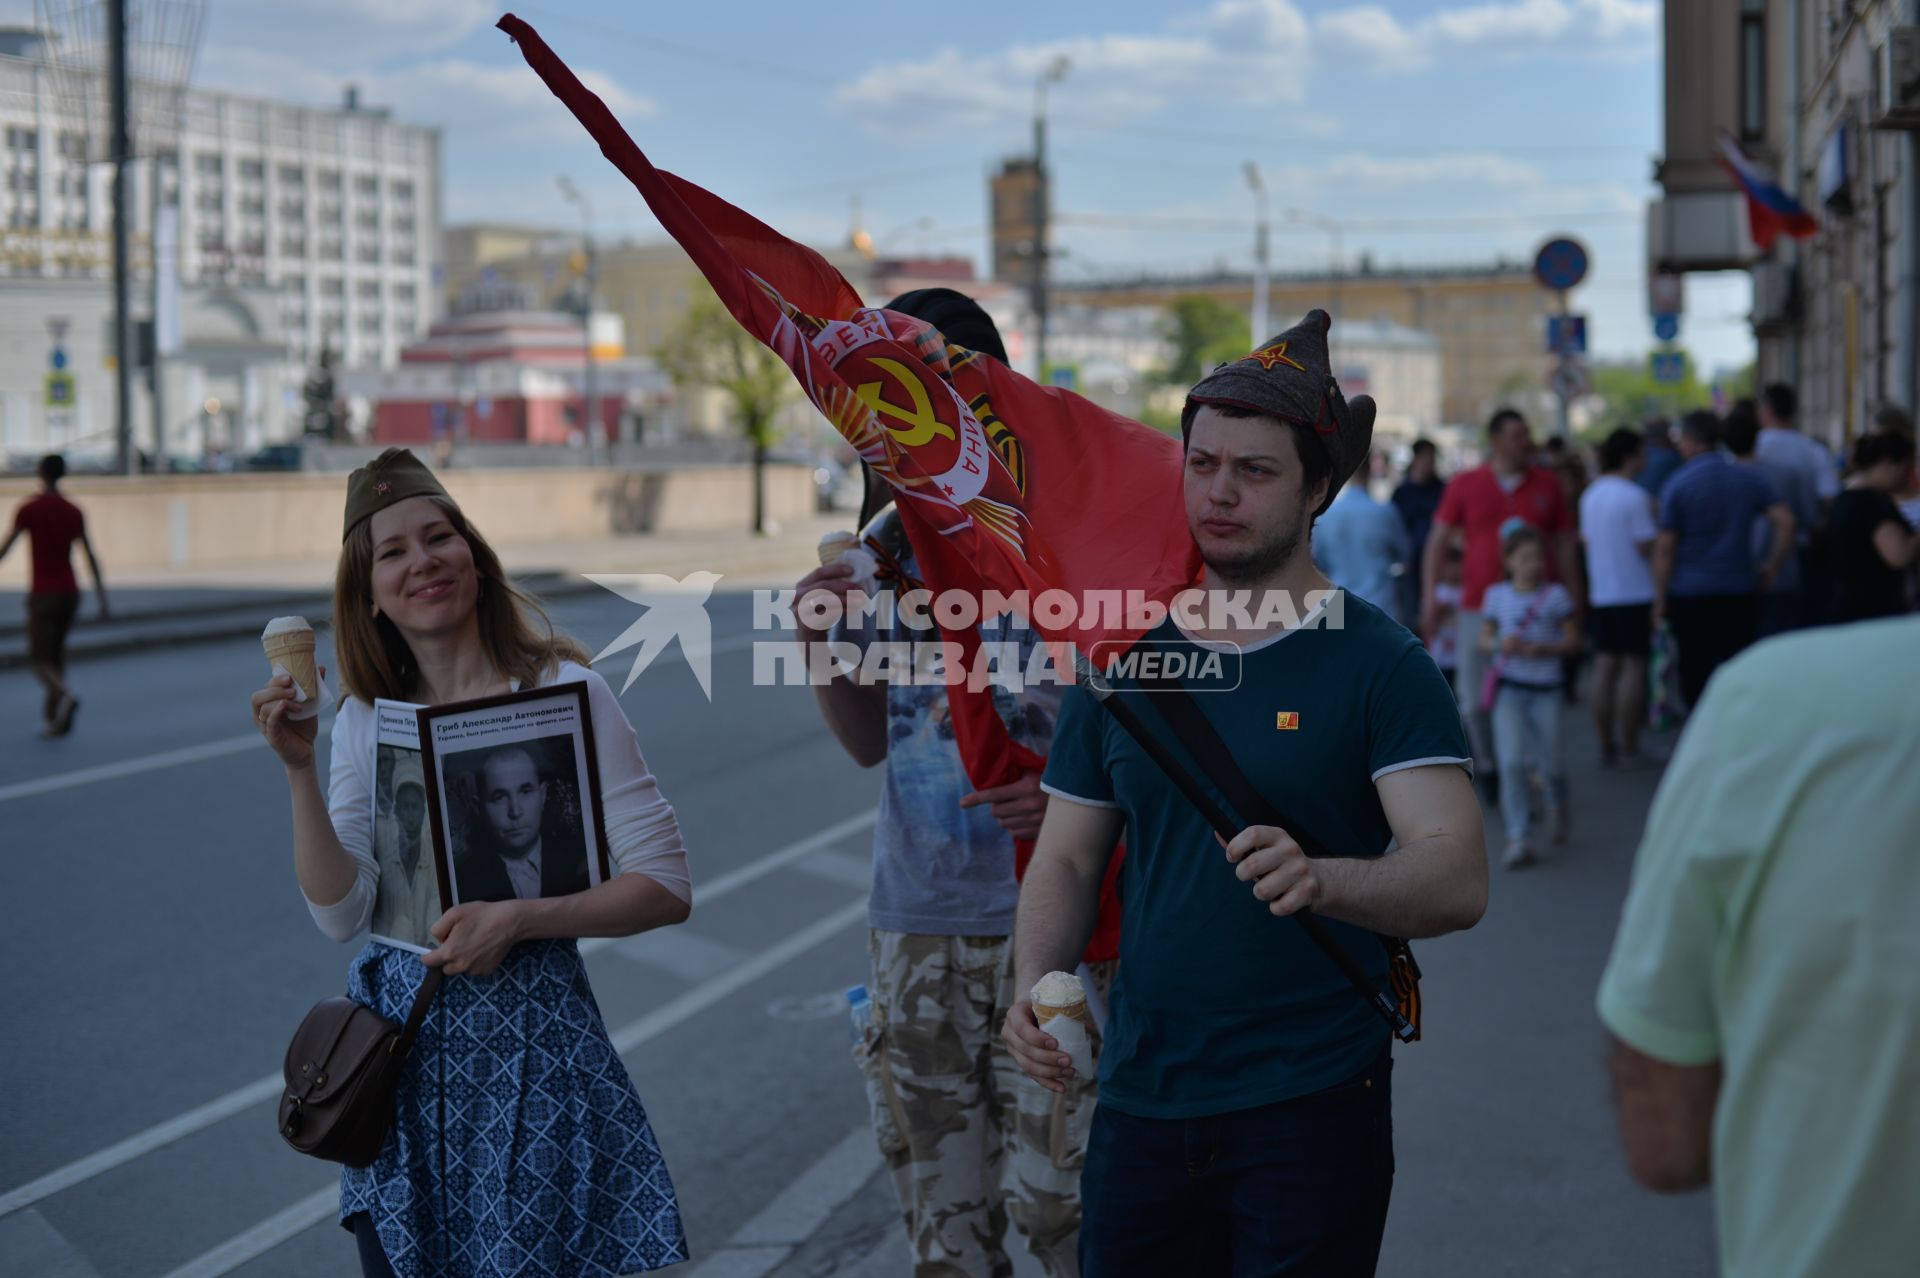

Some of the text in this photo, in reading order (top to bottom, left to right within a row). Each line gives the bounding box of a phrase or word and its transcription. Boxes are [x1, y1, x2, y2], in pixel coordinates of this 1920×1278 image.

[436, 705, 574, 734] Гриб Александр Автономович
